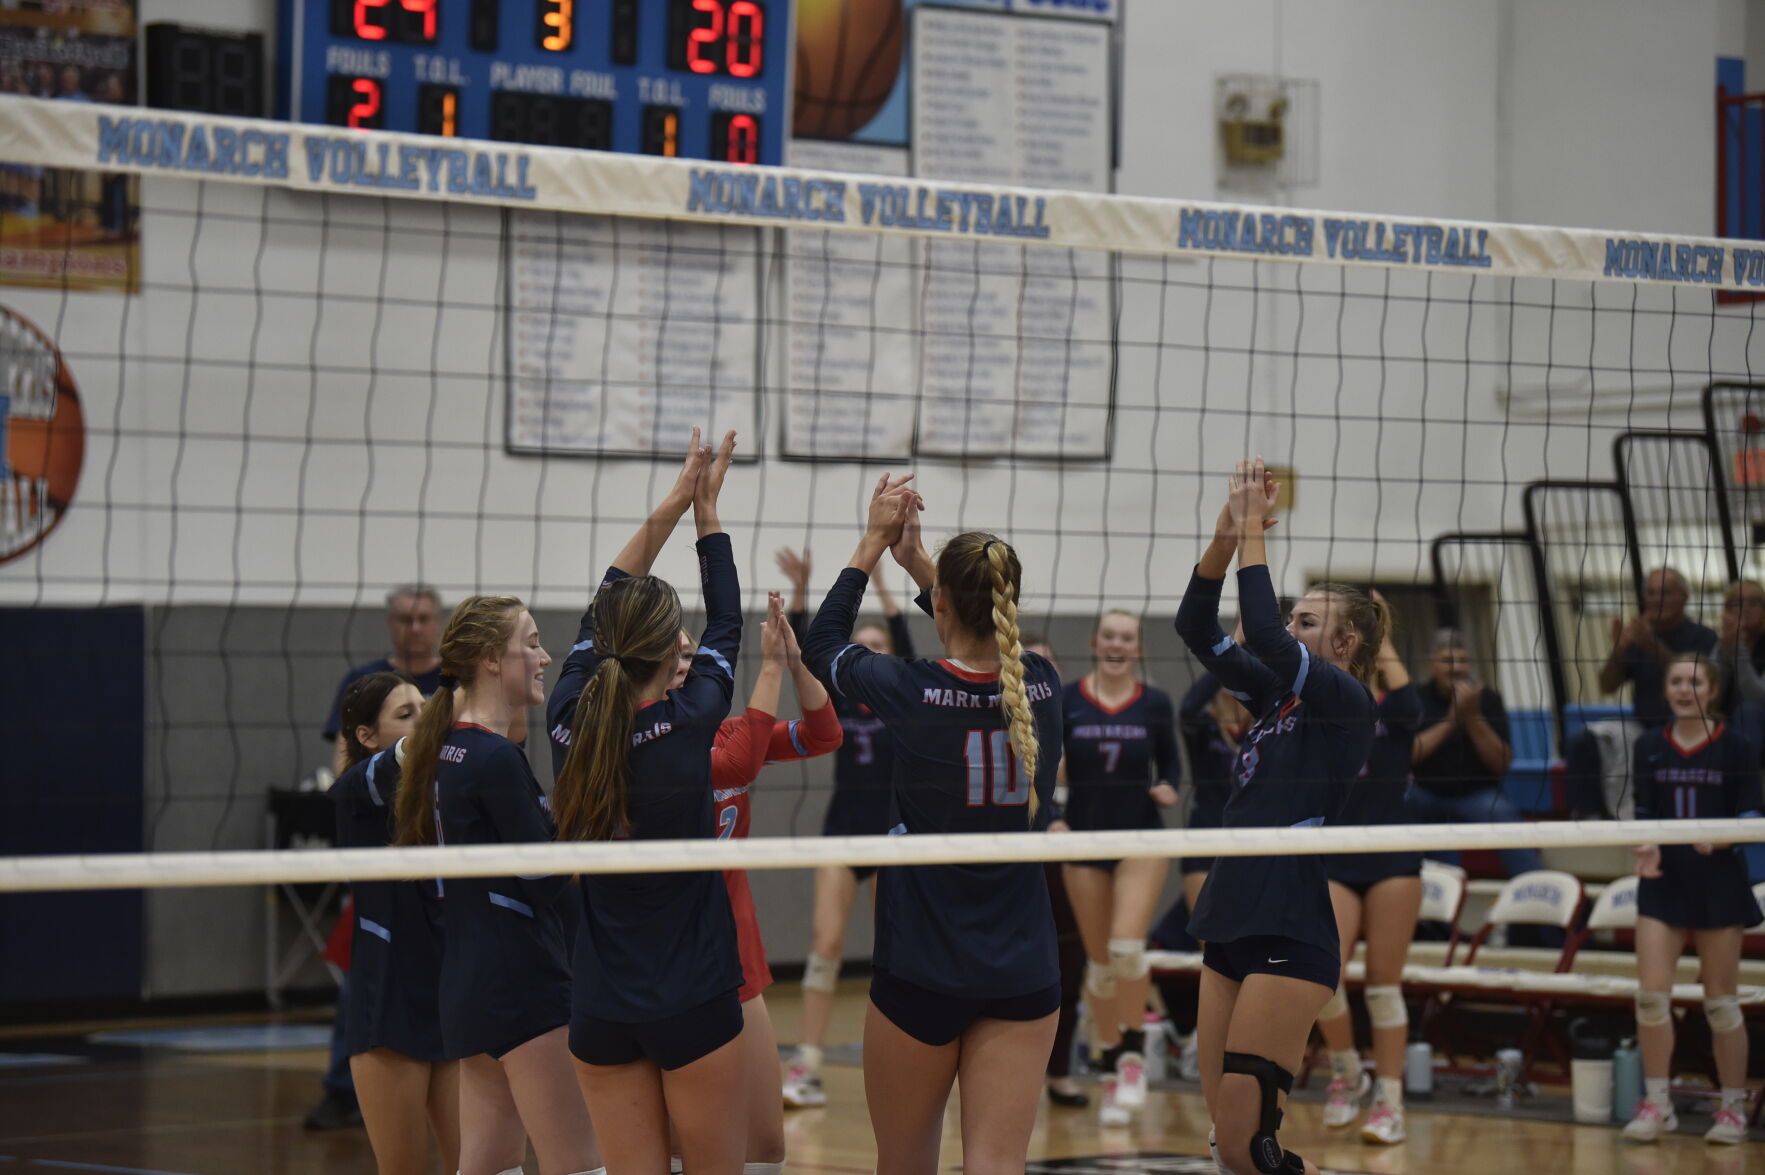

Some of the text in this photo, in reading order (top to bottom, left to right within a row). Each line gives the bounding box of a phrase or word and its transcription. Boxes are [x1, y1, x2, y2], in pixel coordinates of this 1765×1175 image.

[543, 0, 573, 51] 3
[687, 0, 763, 77] 20
[326, 46, 391, 78] FOULS
[490, 62, 616, 99] PLAYER FOUL
[348, 79, 380, 132] 2
[442, 92, 456, 137] 1
[708, 83, 767, 113] FOULS
[97, 115, 537, 200] MONARCH VOLLEYBALL
[664, 113, 677, 157] 1
[727, 114, 757, 165] 0
[687, 168, 1050, 239] MONARCH VOLLEYBALL
[1177, 208, 1492, 267] MONARCH VOLLEYBALL
[1603, 238, 1765, 286] MONARCH VO
[922, 681, 1052, 708] MARK MRIS
[964, 729, 1030, 806] 10
[1098, 741, 1121, 773] 7
[1674, 786, 1697, 819] 11
